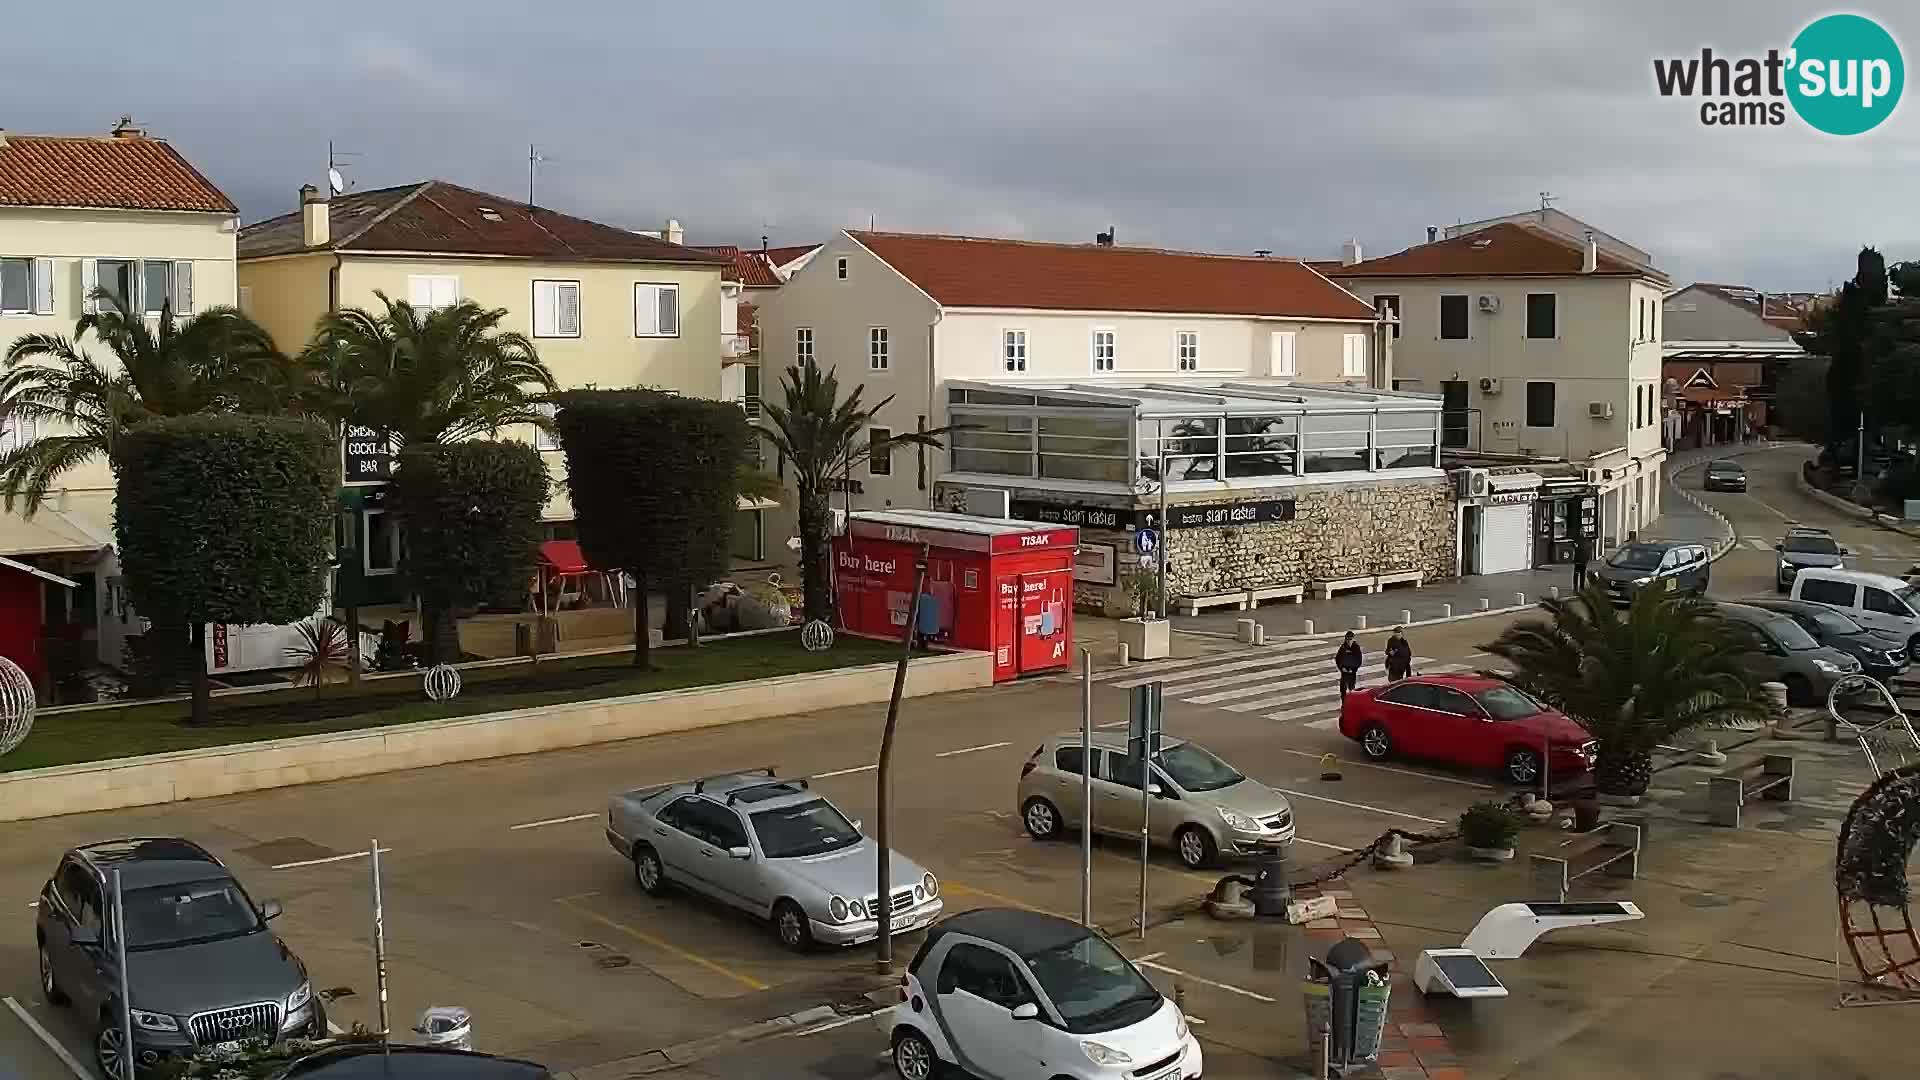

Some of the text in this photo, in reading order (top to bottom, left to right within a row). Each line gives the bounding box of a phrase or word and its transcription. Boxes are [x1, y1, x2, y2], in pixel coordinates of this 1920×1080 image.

[348, 442, 389, 456] COCKTL
[360, 460, 378, 472] BAR
[1020, 534, 1049, 547] TISAK
[864, 554, 897, 574] here!
[1001, 578, 1047, 595] Buy here!
